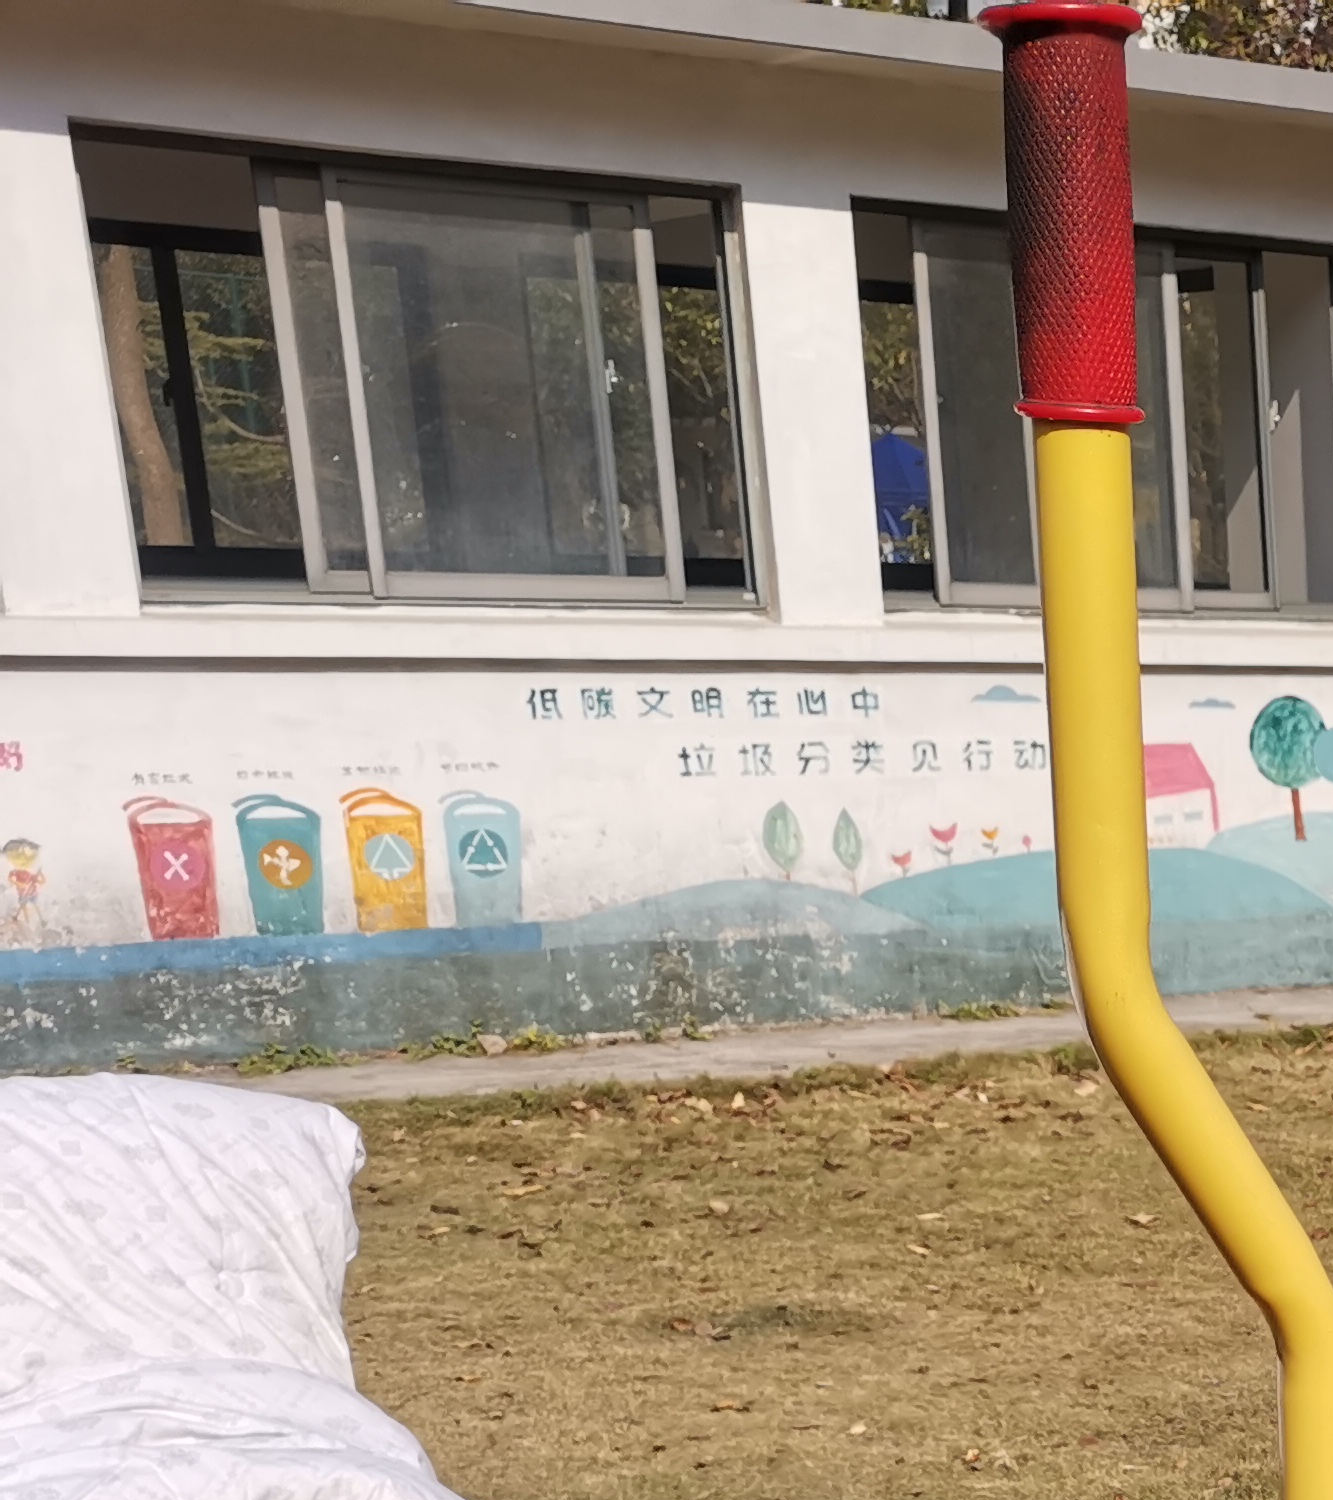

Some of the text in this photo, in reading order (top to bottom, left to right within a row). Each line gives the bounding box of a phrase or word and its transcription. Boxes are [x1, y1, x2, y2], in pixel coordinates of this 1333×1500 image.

[526, 686, 880, 720] 低碳文明在心中
[678, 737, 1047, 777] 垃圾分类见行动
